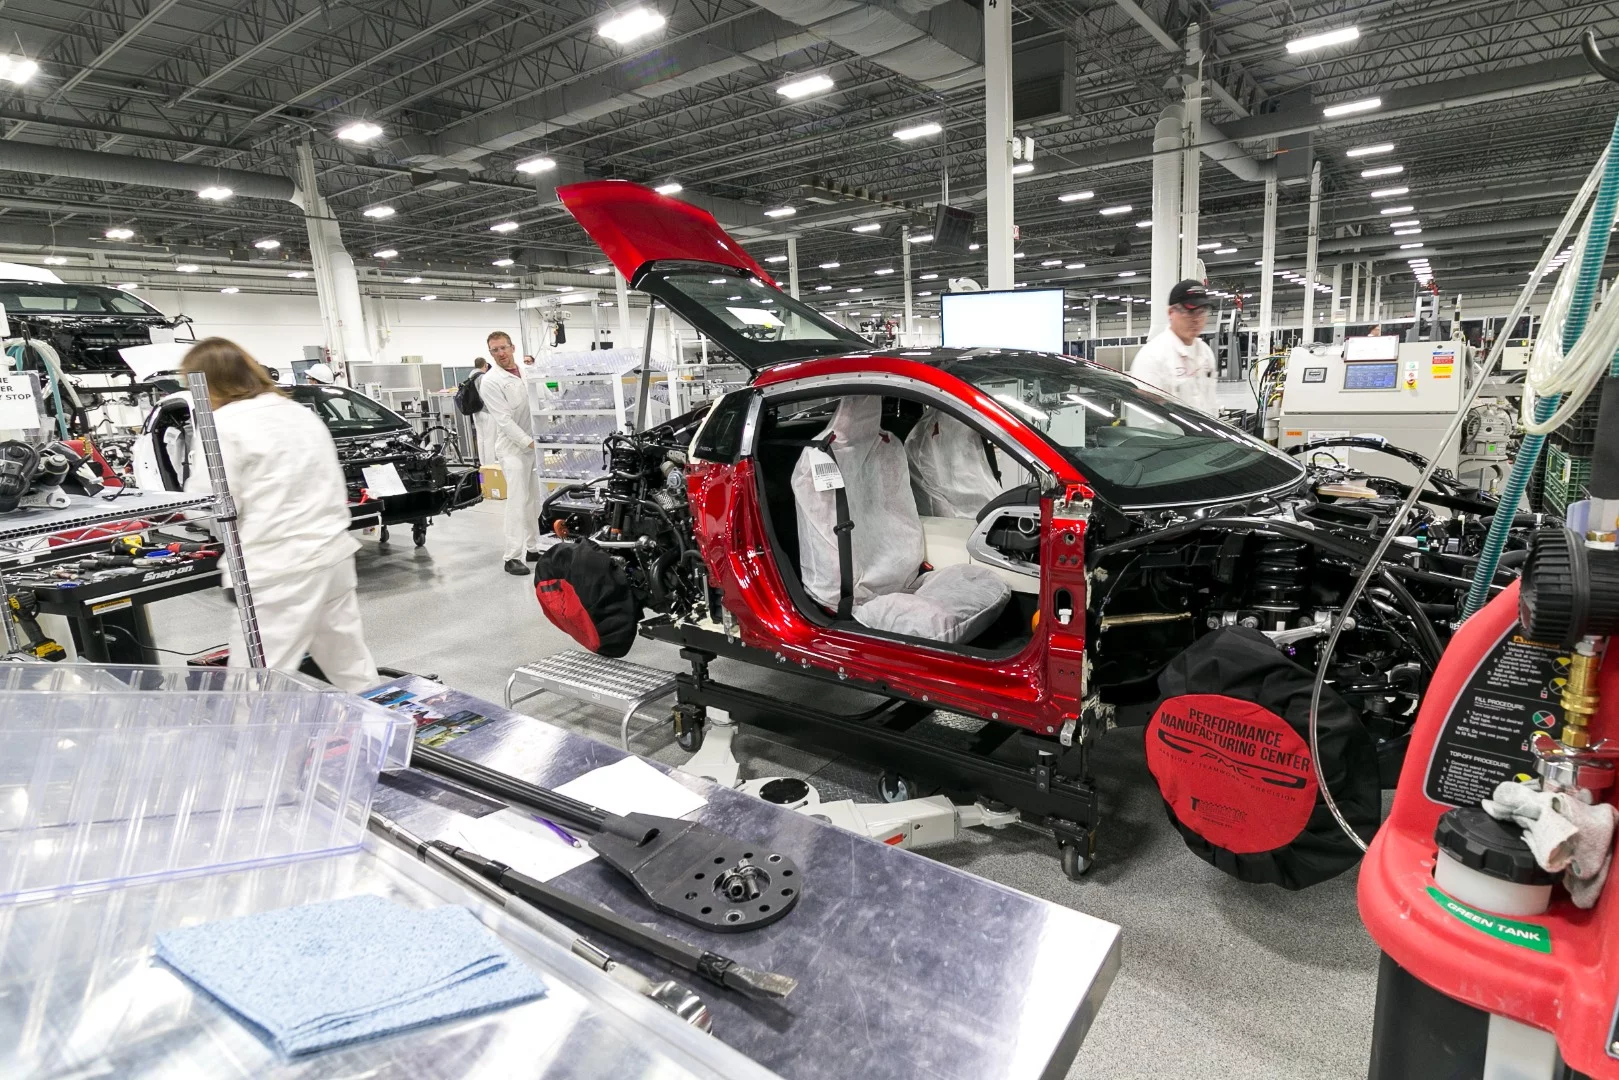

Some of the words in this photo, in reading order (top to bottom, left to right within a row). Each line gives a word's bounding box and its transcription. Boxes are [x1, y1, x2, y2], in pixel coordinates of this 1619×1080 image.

[142, 565, 194, 582] Snap-on
[1487, 699, 1525, 710] PROCEDURE:
[1190, 708, 1283, 748] PERFORMANCE
[1160, 712, 1256, 757] MANUFACTURING
[1260, 746, 1310, 772] CENTER
[1200, 752, 1254, 779] PMC
[1450, 751, 1473, 759] TOP-OFF
[1474, 756, 1511, 769] PROCEDURE:
[1250, 785, 1296, 802] PRECISION
[1447, 902, 1493, 928] GREEN
[1497, 924, 1540, 941] TANK
